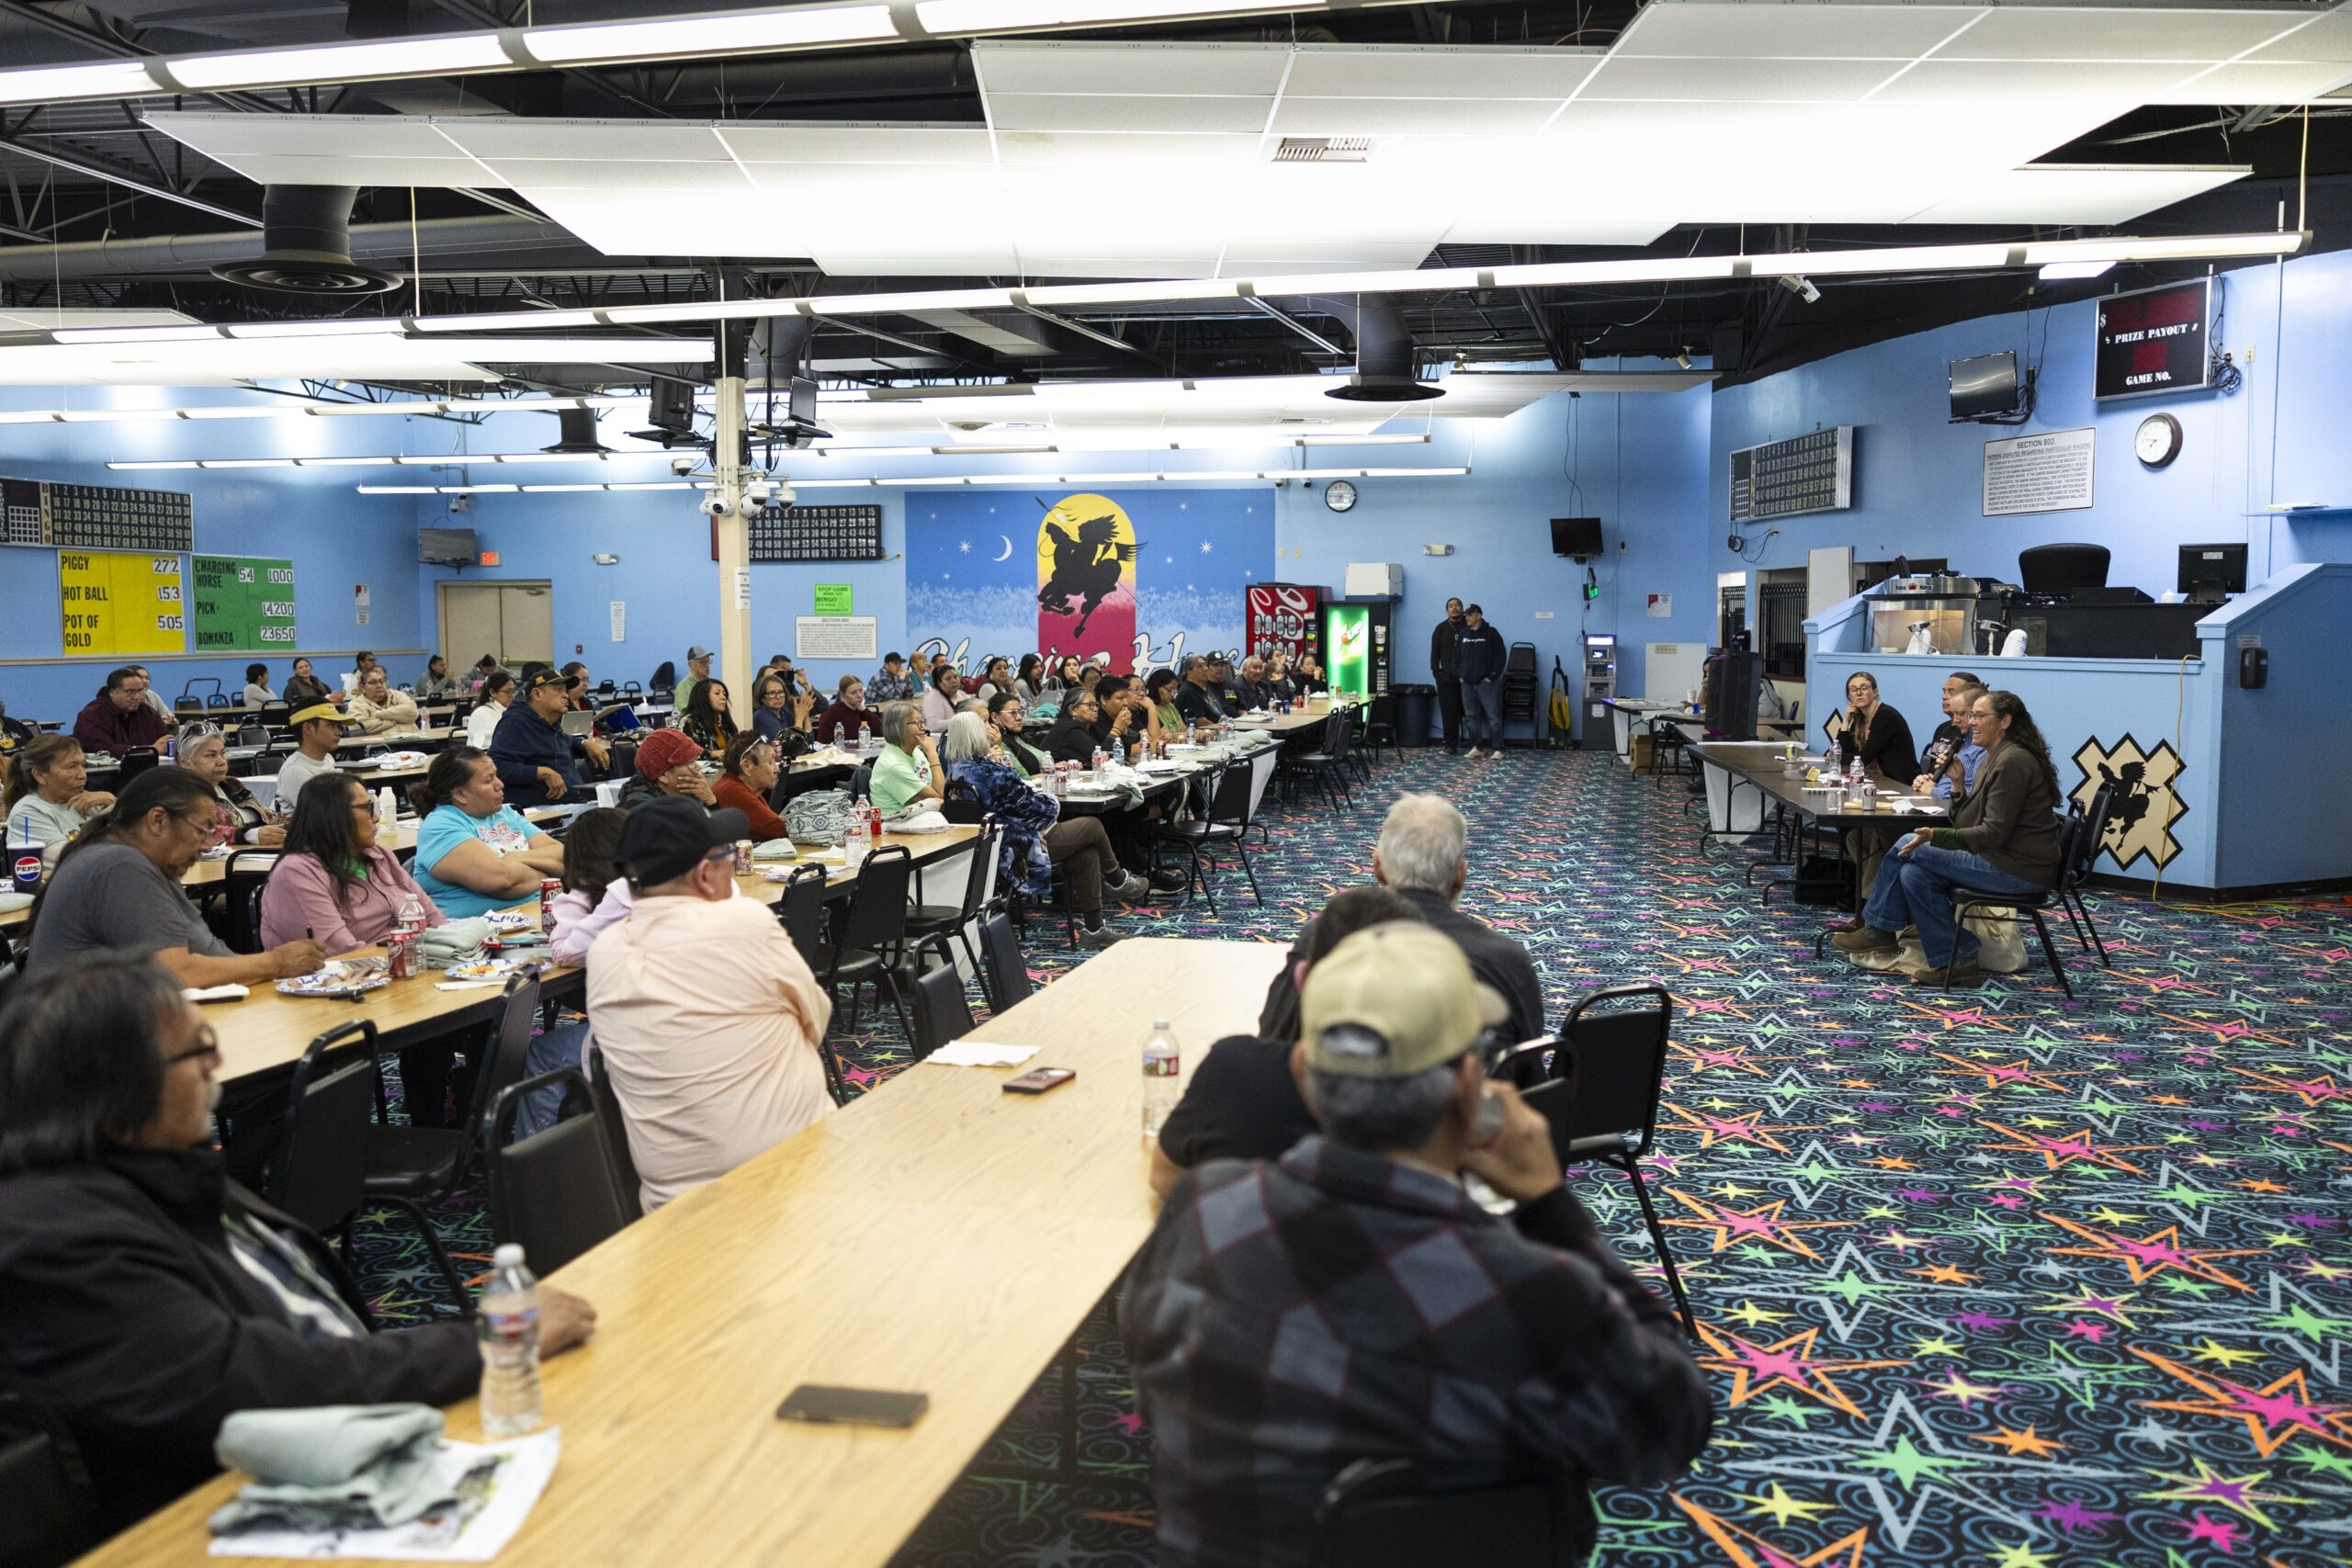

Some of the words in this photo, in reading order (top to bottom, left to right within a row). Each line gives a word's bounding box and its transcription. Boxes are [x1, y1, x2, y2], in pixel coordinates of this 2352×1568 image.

[2099, 313, 2107, 329] $
[2114, 331, 2145, 344] PRIZE
[2148, 323, 2188, 339] PAYOUT
[2126, 373, 2153, 386] GAME
[2155, 371, 2171, 382] NO.
[2017, 439, 2042, 449] SECTION
[2021, 447, 2045, 457] REGARDING
[2045, 445, 2072, 454] PARTICULAR
[139, 491, 145, 502] 10
[148, 492, 154, 502] 11
[156, 493, 163, 502] 12
[165, 494, 172, 503] 13
[175, 495, 181, 503] 14
[183, 495, 189, 505] 15
[41, 483, 51, 544] BINGO
[53, 497, 61, 507] 16
[63, 497, 70, 507] 17
[74, 498, 81, 509] 18
[84, 499, 90, 509] 19
[92, 500, 100, 510] 20
[102, 501, 109, 511] 21
[111, 502, 119, 512] 22
[120, 502, 129, 512] 23
[130, 502, 138, 513] 24
[139, 503, 146, 513] 25
[148, 503, 155, 513] 26
[157, 504, 164, 514] 27
[165, 505, 173, 515] 28
[175, 506, 182, 515] 29
[183, 506, 191, 516] 30
[53, 509, 62, 519] 31
[63, 510, 72, 520] 32
[74, 511, 82, 521] 33
[83, 511, 91, 521] 34
[93, 512, 101, 522] 35
[102, 513, 110, 523] 36
[112, 513, 119, 523] 37
[121, 513, 129, 524] 38
[130, 514, 138, 525] 39
[140, 515, 147, 525] 40
[149, 515, 156, 525] 41
[157, 516, 165, 526] 42
[166, 517, 174, 526] 43
[175, 517, 182, 526] 44
[184, 518, 191, 527] 45
[54, 522, 62, 532] 46
[64, 523, 72, 532] 47
[74, 523, 82, 533] 48
[84, 524, 92, 534] 49
[93, 524, 101, 534] 50
[103, 525, 110, 535] 51
[112, 525, 120, 536] 52
[122, 525, 130, 536] 53
[131, 526, 139, 536] 54
[141, 526, 148, 536] 55
[150, 527, 157, 536] 56
[158, 528, 165, 537] 57
[166, 528, 174, 538] 58
[175, 529, 183, 538] 59
[184, 529, 192, 539] 60
[755, 529, 763, 538] 33
[764, 529, 772, 538] 34
[774, 529, 782, 538] 35
[783, 529, 790, 538] 36
[792, 529, 799, 537] 37
[802, 529, 809, 537] 38
[811, 529, 819, 537] 39
[820, 529, 829, 537] 40
[839, 528, 847, 537] 42
[849, 528, 856, 536] 43
[858, 528, 865, 536] 44
[868, 527, 876, 536] 45
[755, 550, 763, 558] 63
[764, 550, 772, 558] 64
[774, 549, 782, 558] 65
[783, 549, 791, 558] 66
[793, 549, 800, 558] 67
[802, 549, 810, 558] 68
[811, 549, 820, 558] 69
[821, 549, 829, 558] 70
[831, 548, 837, 557] 71
[840, 548, 847, 558] 72
[849, 548, 857, 557] 73
[859, 548, 866, 557] 74
[868, 548, 876, 557] 75
[62, 556, 90, 571] PIGGY
[154, 559, 179, 573] 272
[195, 560, 236, 575] CHARGING
[197, 575, 222, 589] HORSE
[240, 568, 254, 581] 54
[269, 569, 294, 583] 1000
[63, 586, 82, 601] HOT
[85, 587, 108, 602] BALL
[158, 586, 180, 600] 153
[263, 603, 294, 617] 14200
[64, 615, 83, 630] POT
[86, 615, 99, 629] OF
[158, 616, 183, 630] 505
[66, 633, 91, 648] GOLD
[198, 631, 234, 646] BONANZA
[261, 627, 296, 641] 23650
